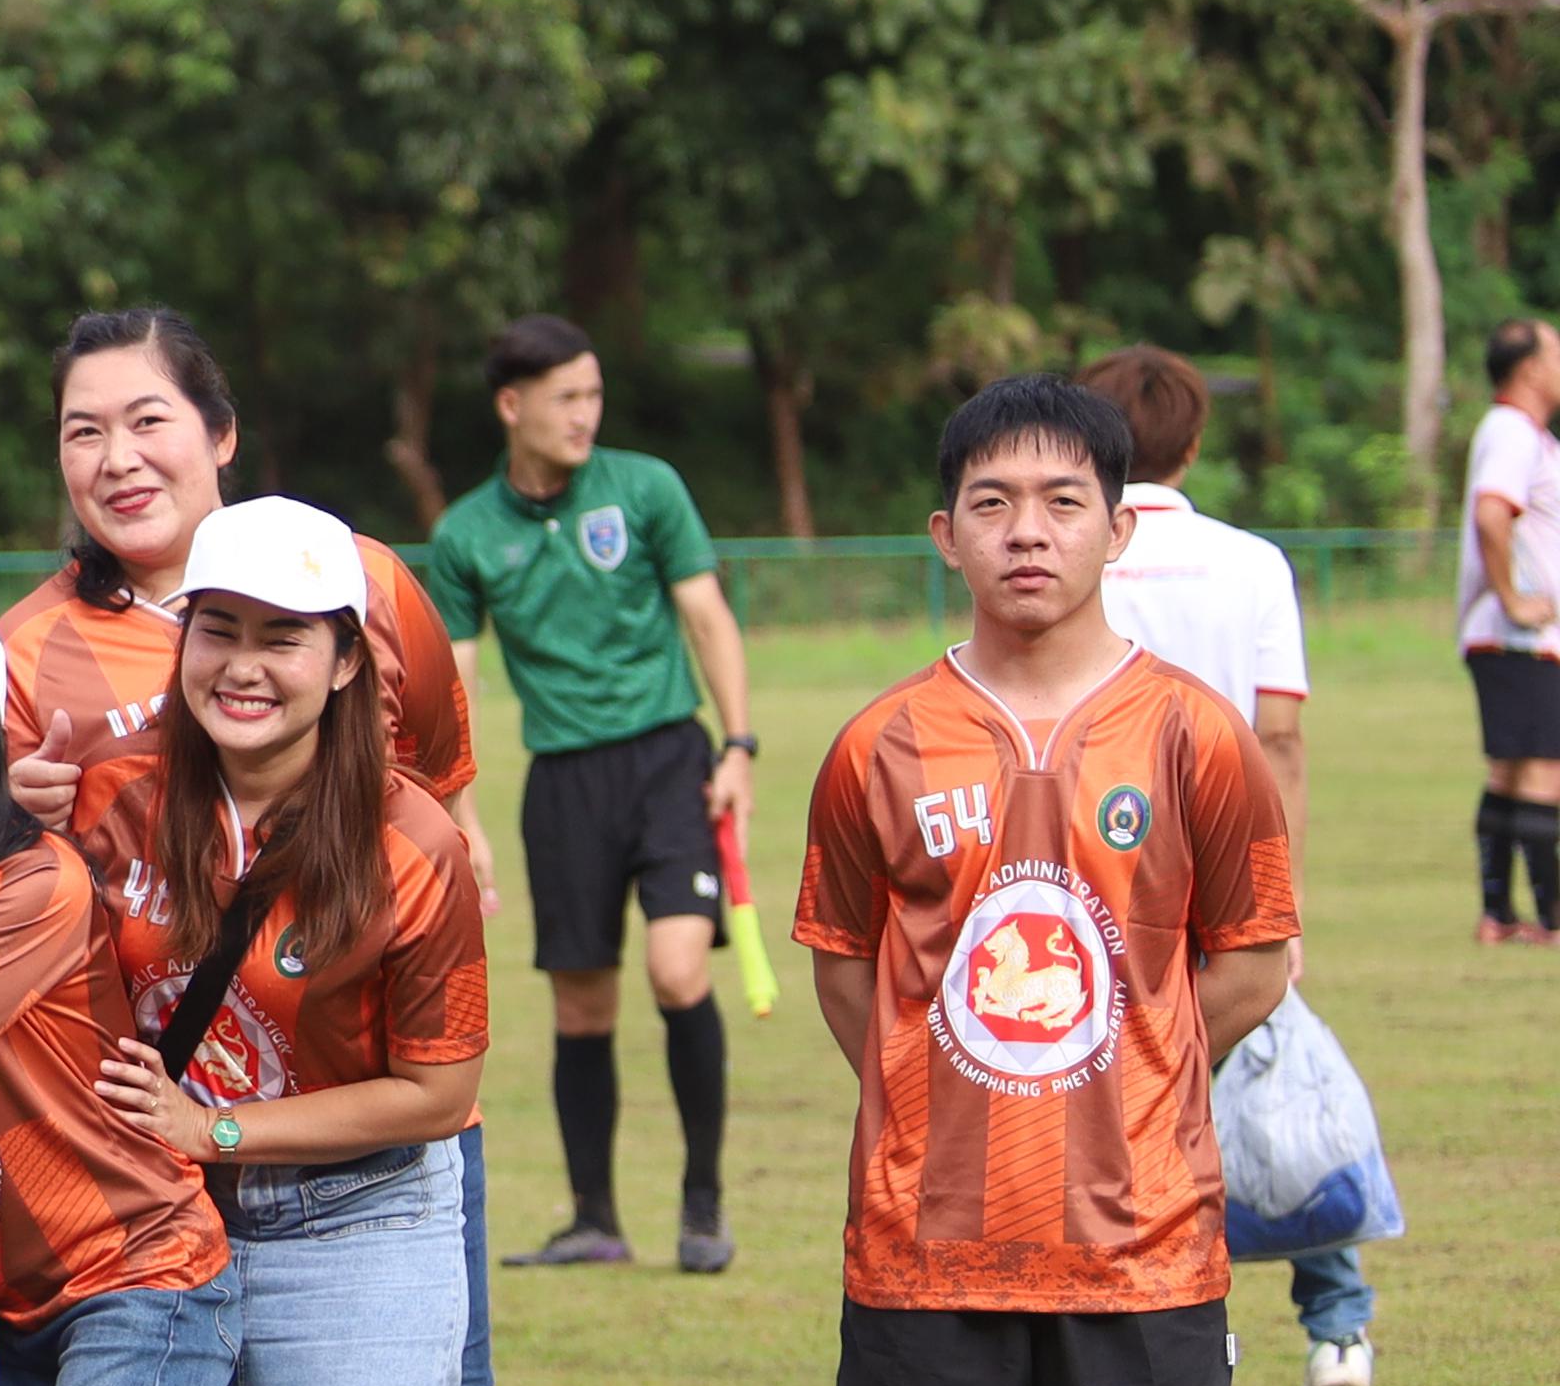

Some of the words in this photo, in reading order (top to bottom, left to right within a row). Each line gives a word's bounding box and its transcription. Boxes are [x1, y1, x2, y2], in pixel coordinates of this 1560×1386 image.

[914, 782, 992, 858] 64
[988, 859, 1126, 956] ADMINISTRATION
[949, 1051, 1041, 1097] KAMPHAENG
[1051, 1067, 1091, 1094] PHET
